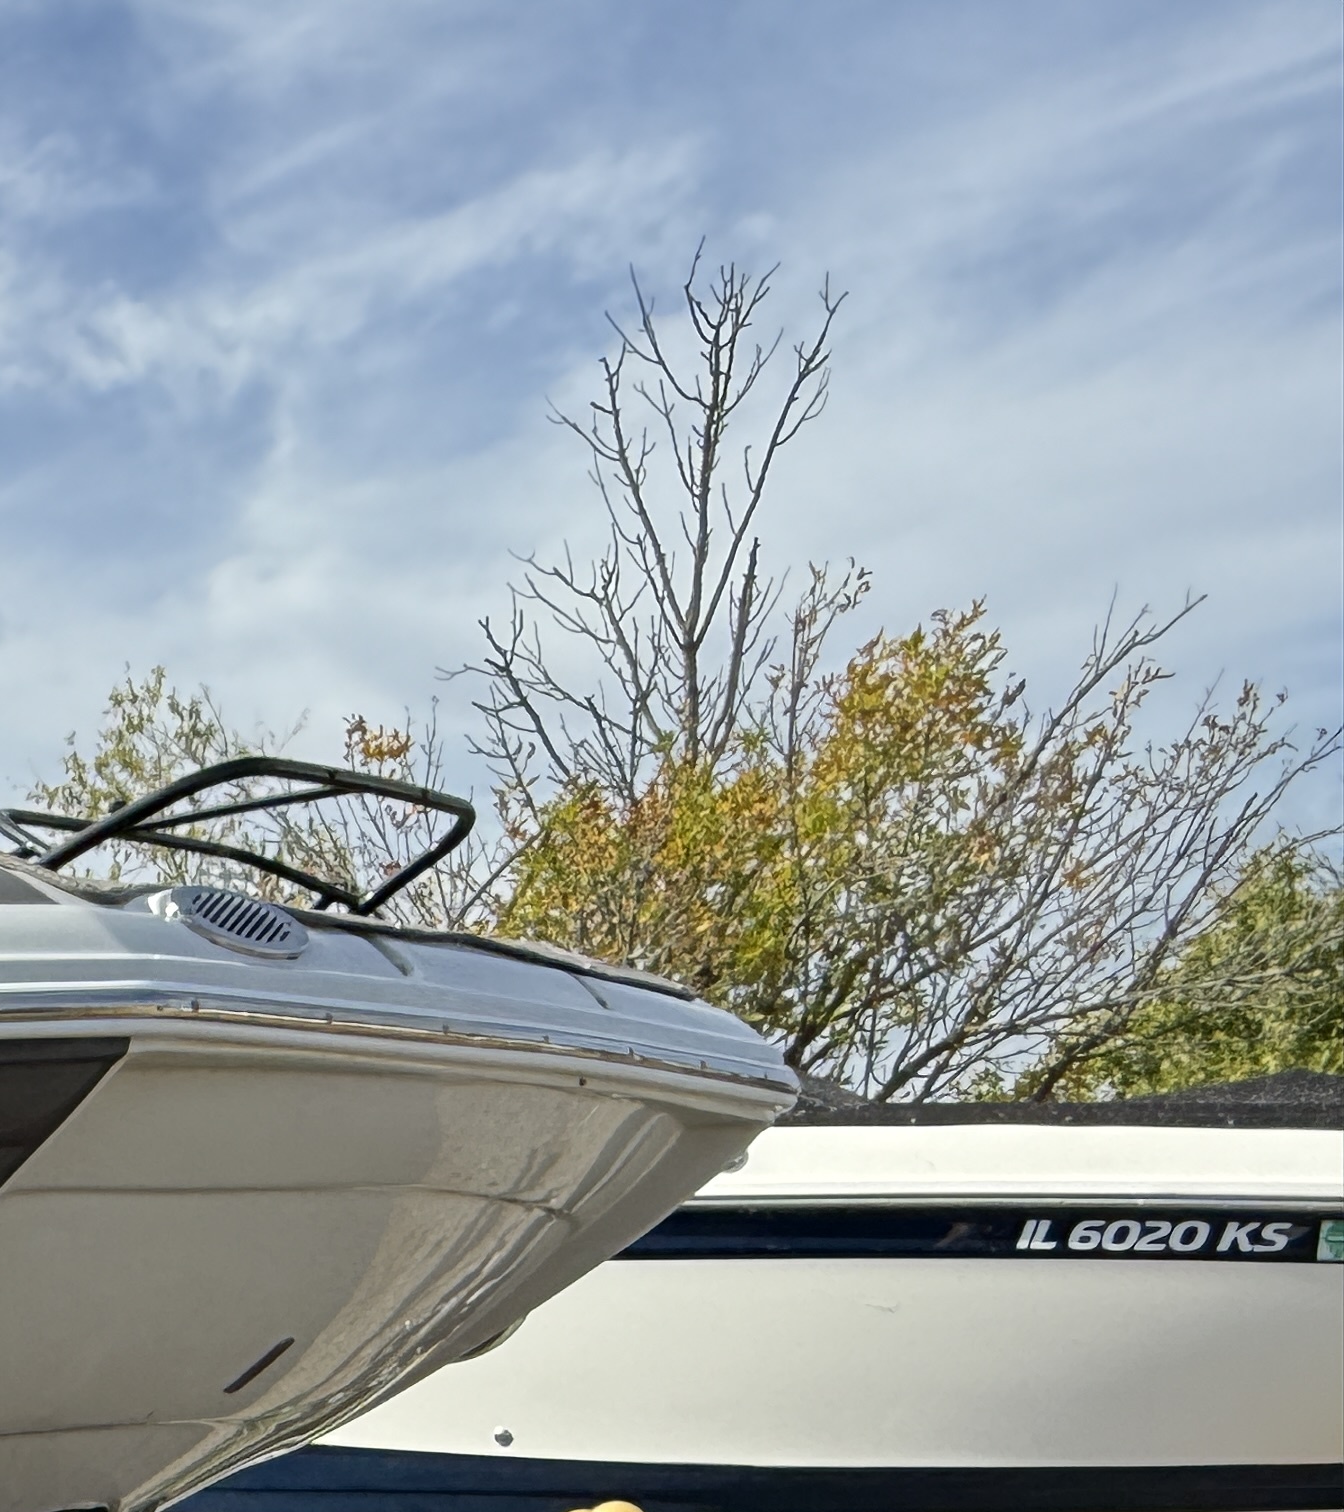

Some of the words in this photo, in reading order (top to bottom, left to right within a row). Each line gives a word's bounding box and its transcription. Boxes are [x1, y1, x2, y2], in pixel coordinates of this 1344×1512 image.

[1015, 1219, 1058, 1251] IL
[1067, 1219, 1211, 1252] 6020
[1216, 1221, 1294, 1253] KS
